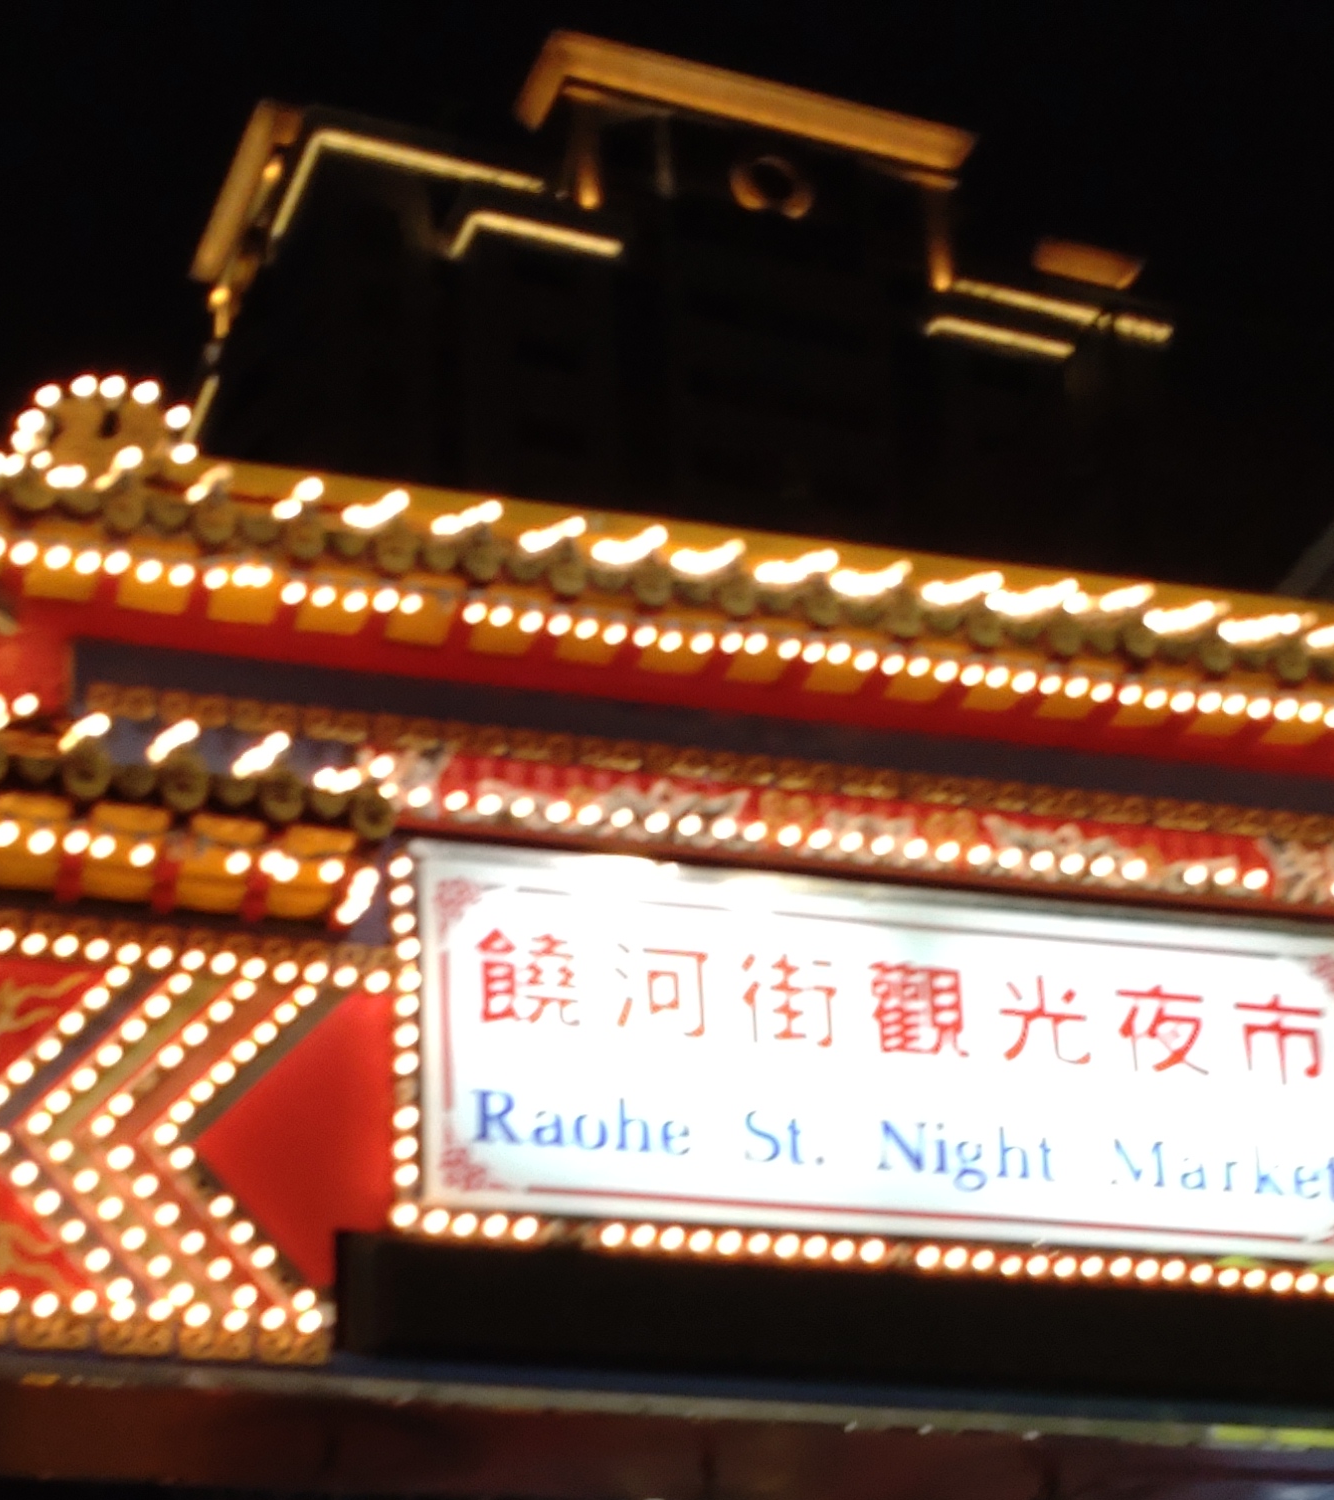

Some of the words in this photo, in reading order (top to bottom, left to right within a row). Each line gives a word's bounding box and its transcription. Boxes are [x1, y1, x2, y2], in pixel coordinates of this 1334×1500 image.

[476, 926, 1327, 1086] 饒河街觀光夜市
[467, 1087, 694, 1158] Raohe
[742, 1108, 826, 1168] St.
[876, 1117, 1058, 1192] Night
